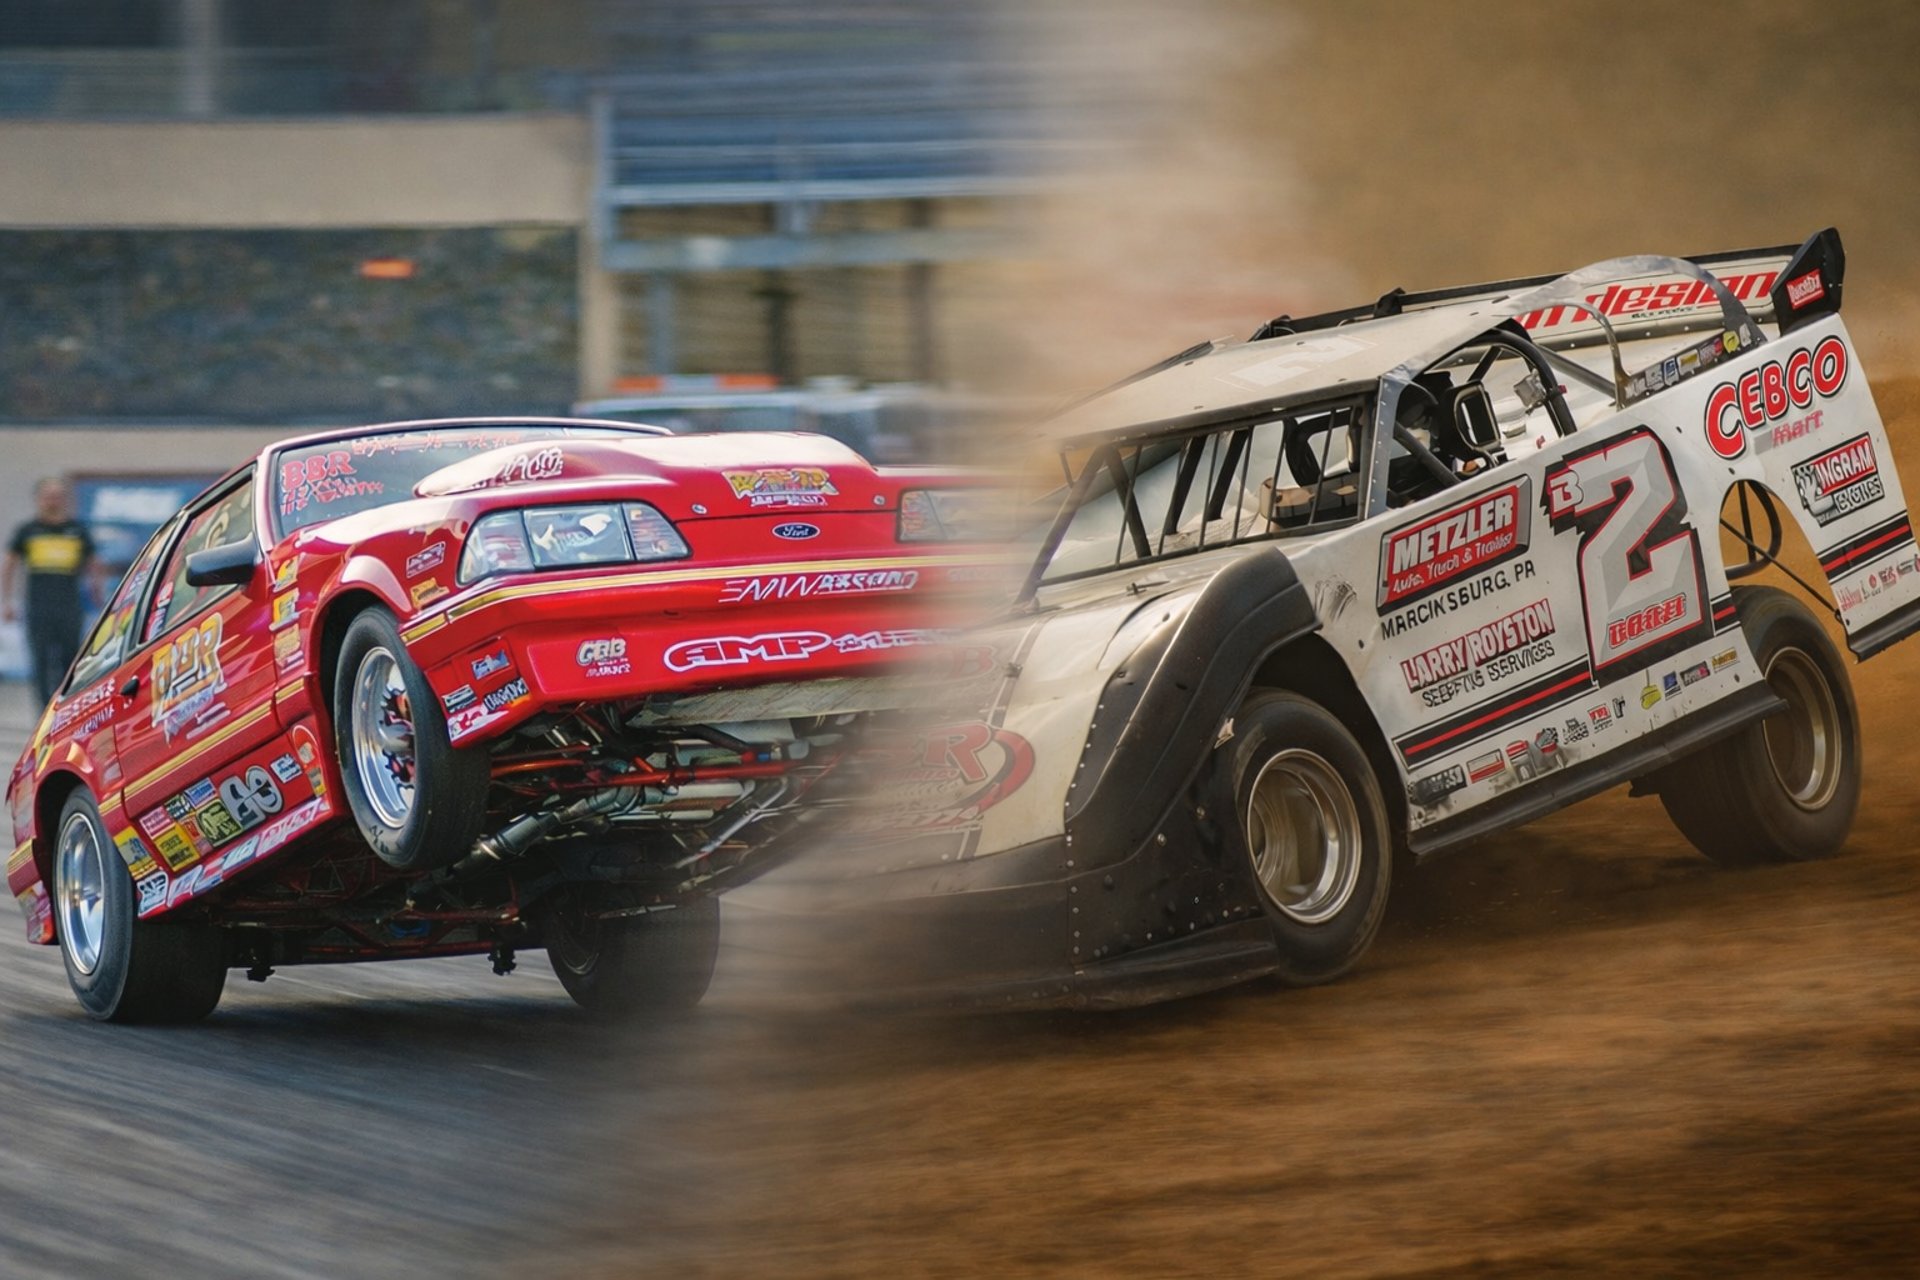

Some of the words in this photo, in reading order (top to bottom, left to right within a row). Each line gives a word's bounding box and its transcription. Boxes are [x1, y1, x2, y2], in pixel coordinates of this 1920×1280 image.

[1705, 335, 1847, 460] CEBCO
[1392, 494, 1515, 575] METZLER
[1514, 559, 1536, 582] PA
[1567, 431, 1704, 669] 2
[1400, 636, 1468, 694] LARRY
[1466, 598, 1556, 667] ROYSTON
